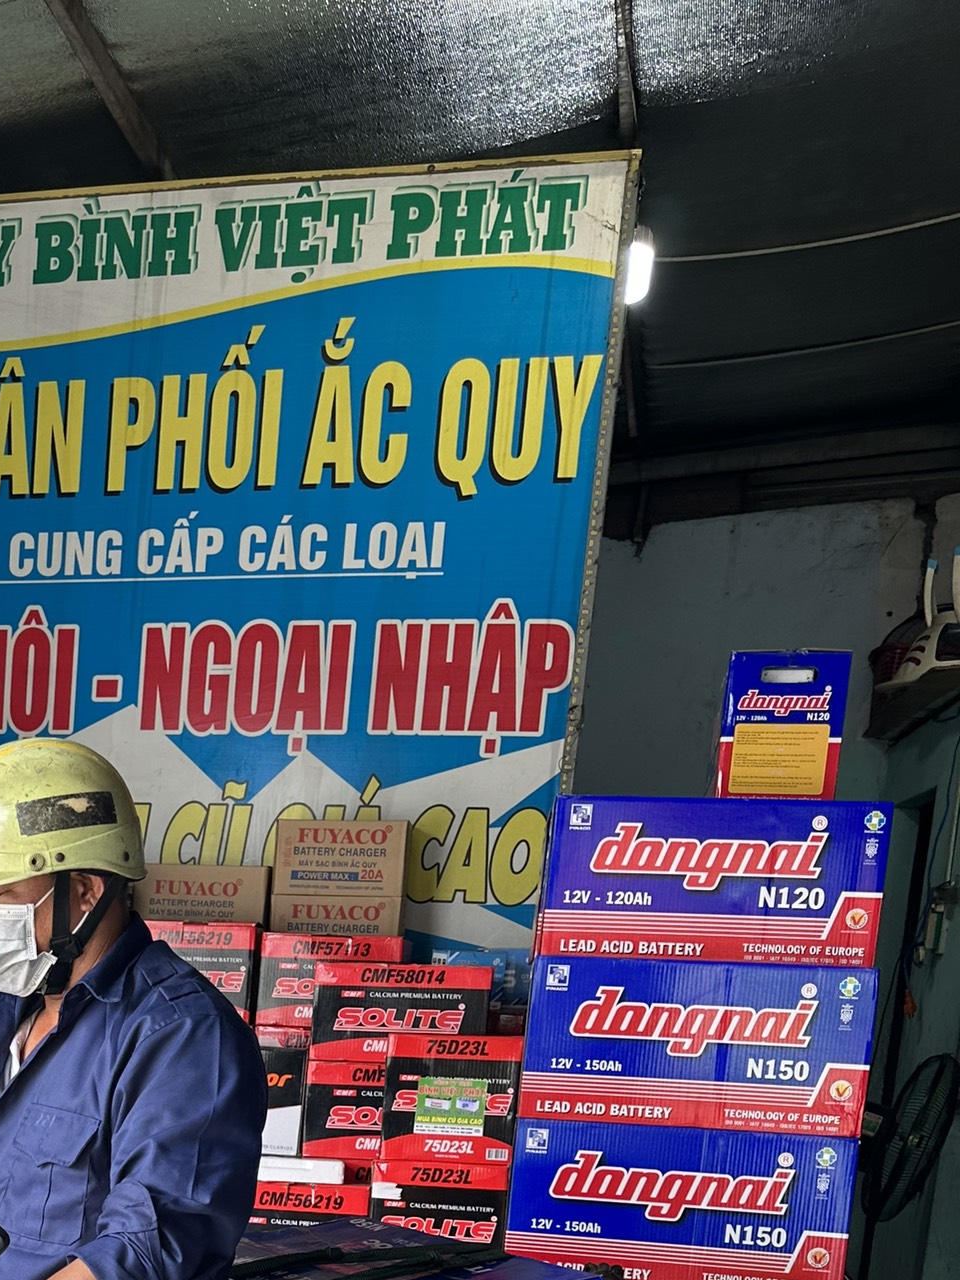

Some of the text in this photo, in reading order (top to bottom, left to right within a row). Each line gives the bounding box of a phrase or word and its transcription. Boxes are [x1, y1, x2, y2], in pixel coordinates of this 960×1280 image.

[34, 196, 201, 286] BÌNH
[216, 181, 371, 284] VIỆT
[388, 168, 590, 260] PHÁT
[105, 324, 279, 496] PHỐI
[304, 317, 411, 489] ẮC
[439, 354, 602, 500] QUY
[9, 530, 122, 577] CUNG
[141, 510, 223, 575] CẤP
[238, 513, 329, 573] CÁC
[343, 521, 446, 579] LOẠI
[138, 620, 356, 756] NGOẠI
[369, 597, 574, 756] NHẬP
[807, 713, 830, 721] N120
[160, 780, 253, 866] CŨ
[407, 804, 551, 907] CAO
[298, 827, 388, 846] FUYACO
[293, 846, 387, 858] BATTERY CHARGER
[297, 869, 384, 881] POWER MAX 20A
[361, 862, 378, 870] QUY
[154, 879, 239, 897] FUYACO
[149, 898, 235, 908] BATTERY CHARGER
[563, 886, 825, 910] 12V 120Ah N120
[291, 903, 380, 921] FUYACO
[287, 922, 379, 934] BATTERY CHARGER
[157, 930, 232, 947] CMF56219
[560, 939, 705, 957] LEAD ACID BATTERY
[743, 943, 865, 957] TECHNOLOGY OF EUROPE
[361, 968, 446, 985] CMF58014
[333, 1007, 465, 1035] SOLITE
[426, 1039, 490, 1057] 75D23L
[550, 1058, 810, 1082] 12V 150Ah N150
[536, 1100, 673, 1120] LEAD ACID BATTERY
[724, 1108, 840, 1124] TECHNOLOGY OF EUROPE
[423, 1139, 474, 1154] 75D23L
[410, 1167, 473, 1185] 75D23L
[259, 1191, 344, 1210] CMF56219
[410, 1202, 495, 1213] CALCIUM PREMIUM BATTERY
[271, 1218, 298, 1226] CALCIUM
[530, 1218, 787, 1248] 12V 150Ah N150
